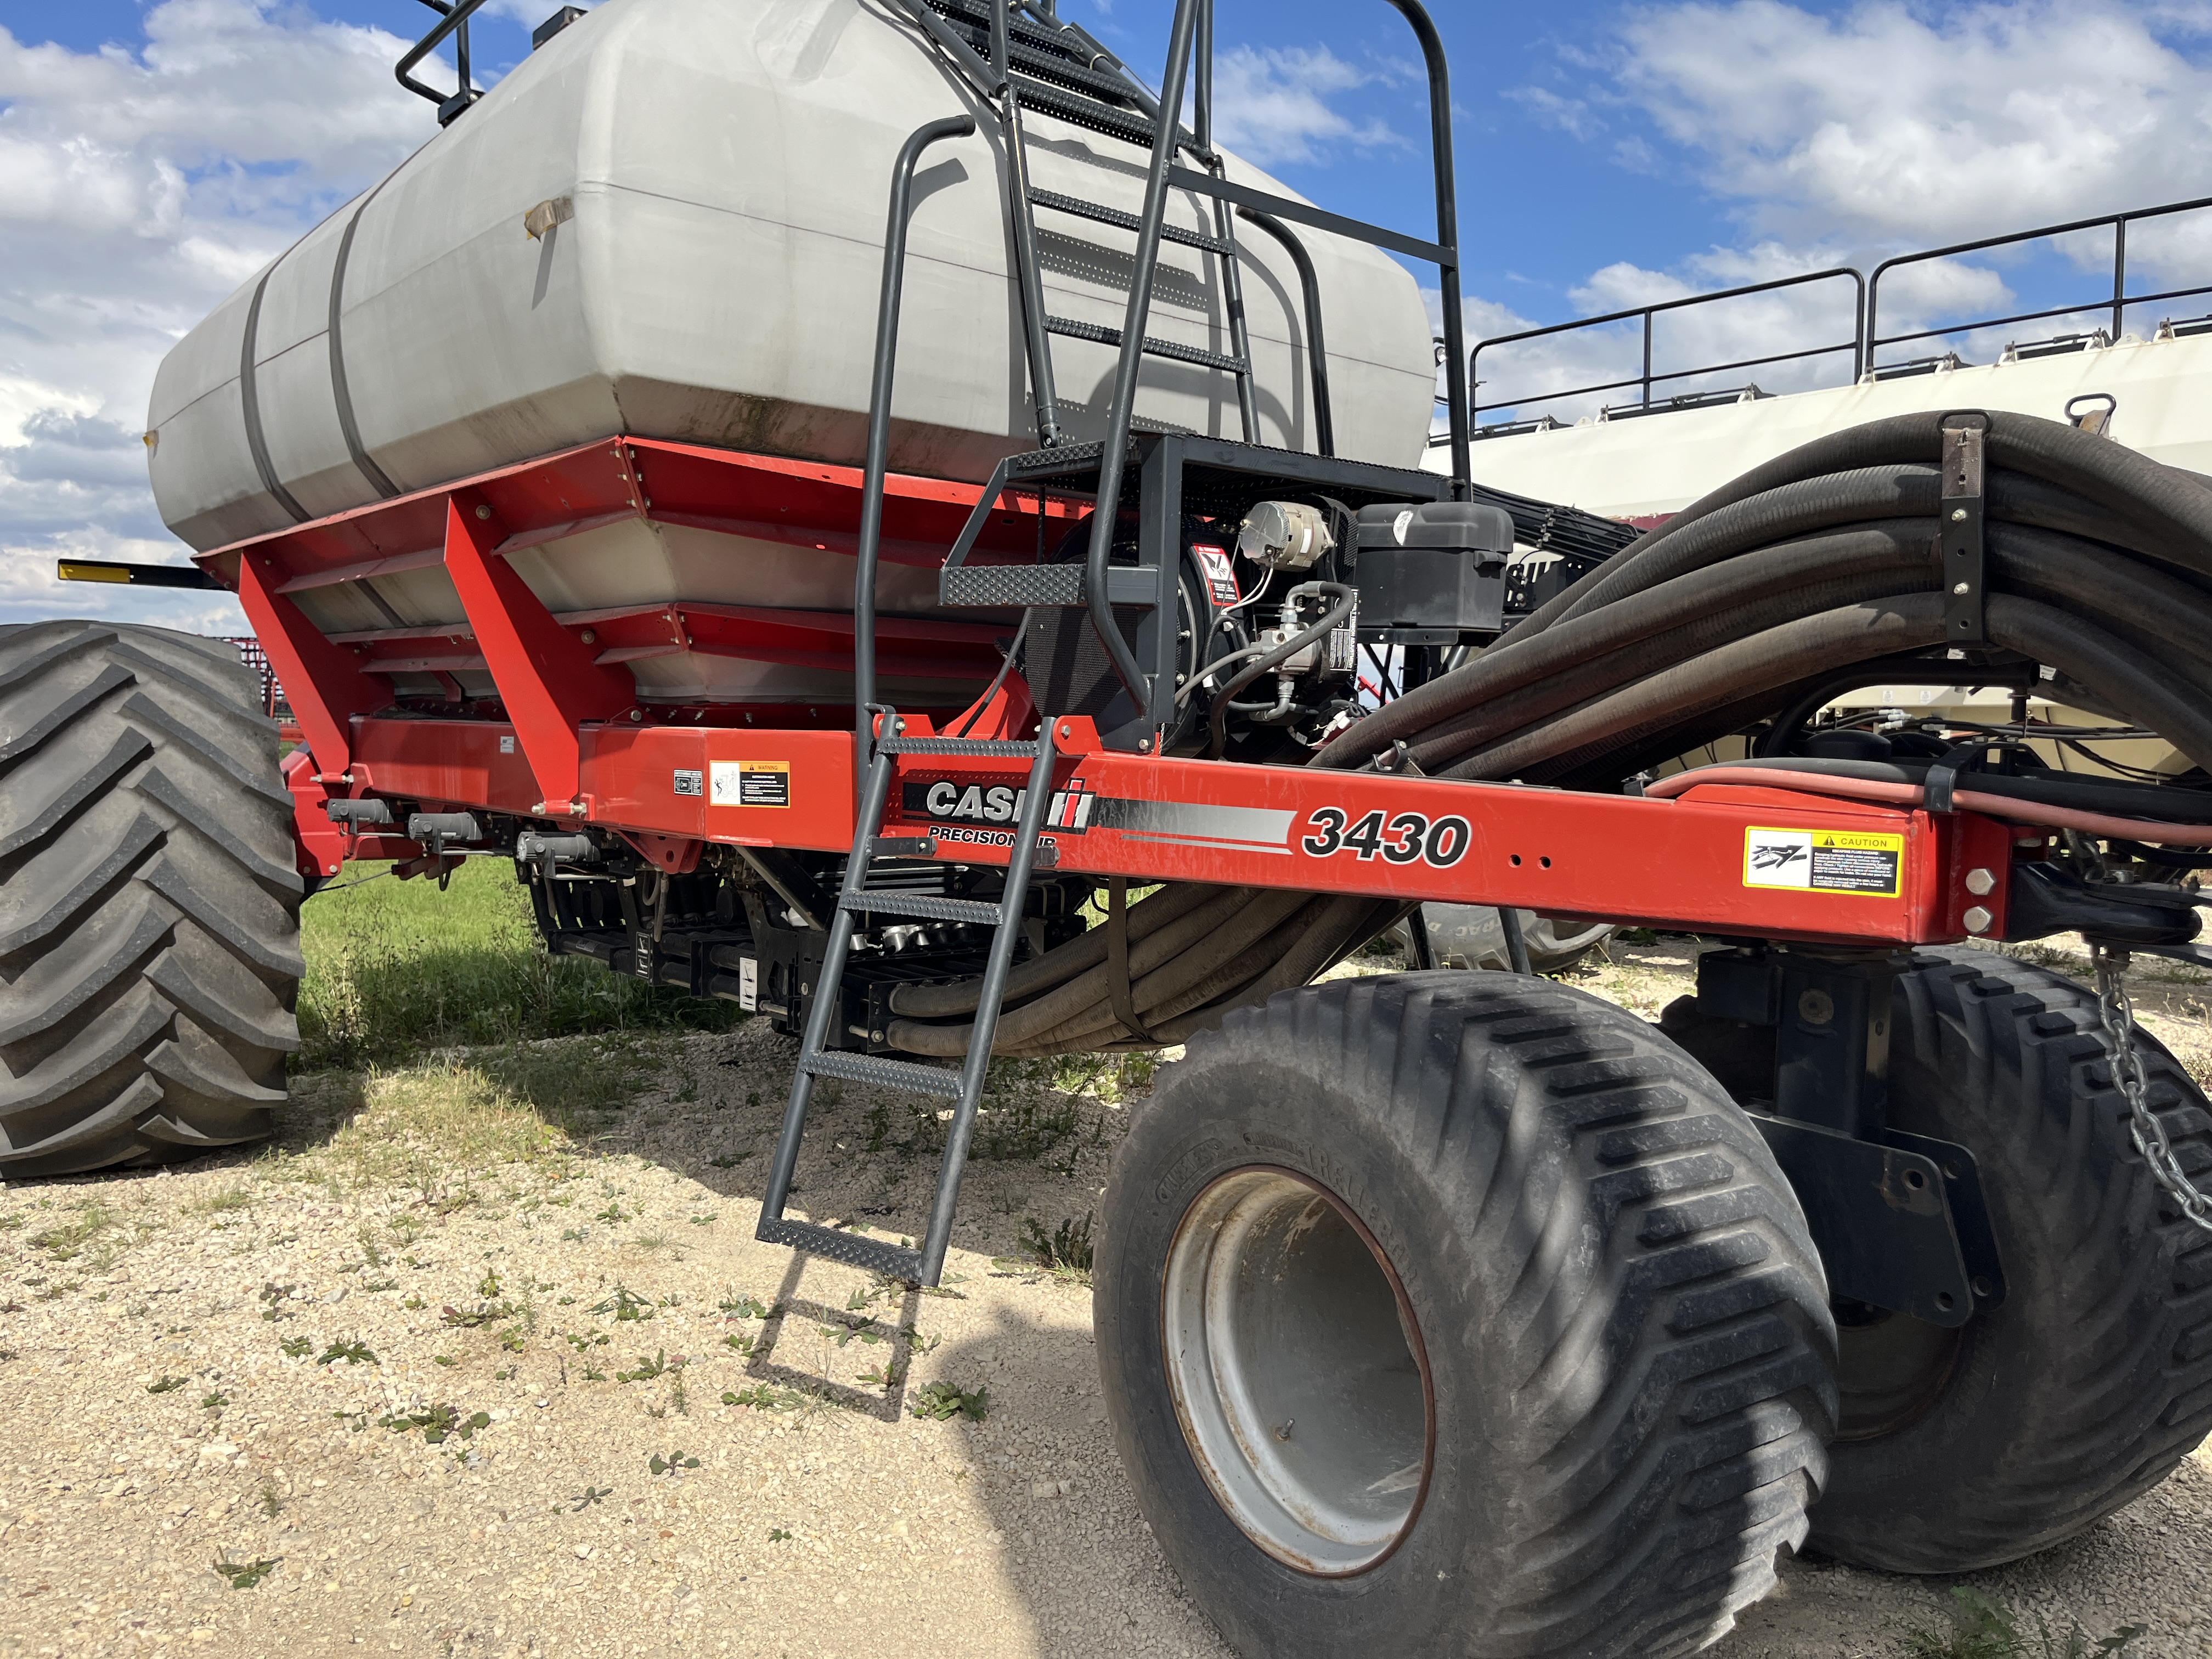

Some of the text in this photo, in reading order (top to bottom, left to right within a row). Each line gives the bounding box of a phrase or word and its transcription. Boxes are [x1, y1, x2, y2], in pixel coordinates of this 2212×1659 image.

[1347, 637, 1356, 669] ADJUSTMENT
[1302, 806, 1471, 870] 3430
[1841, 838, 1887, 847] CAUTION
